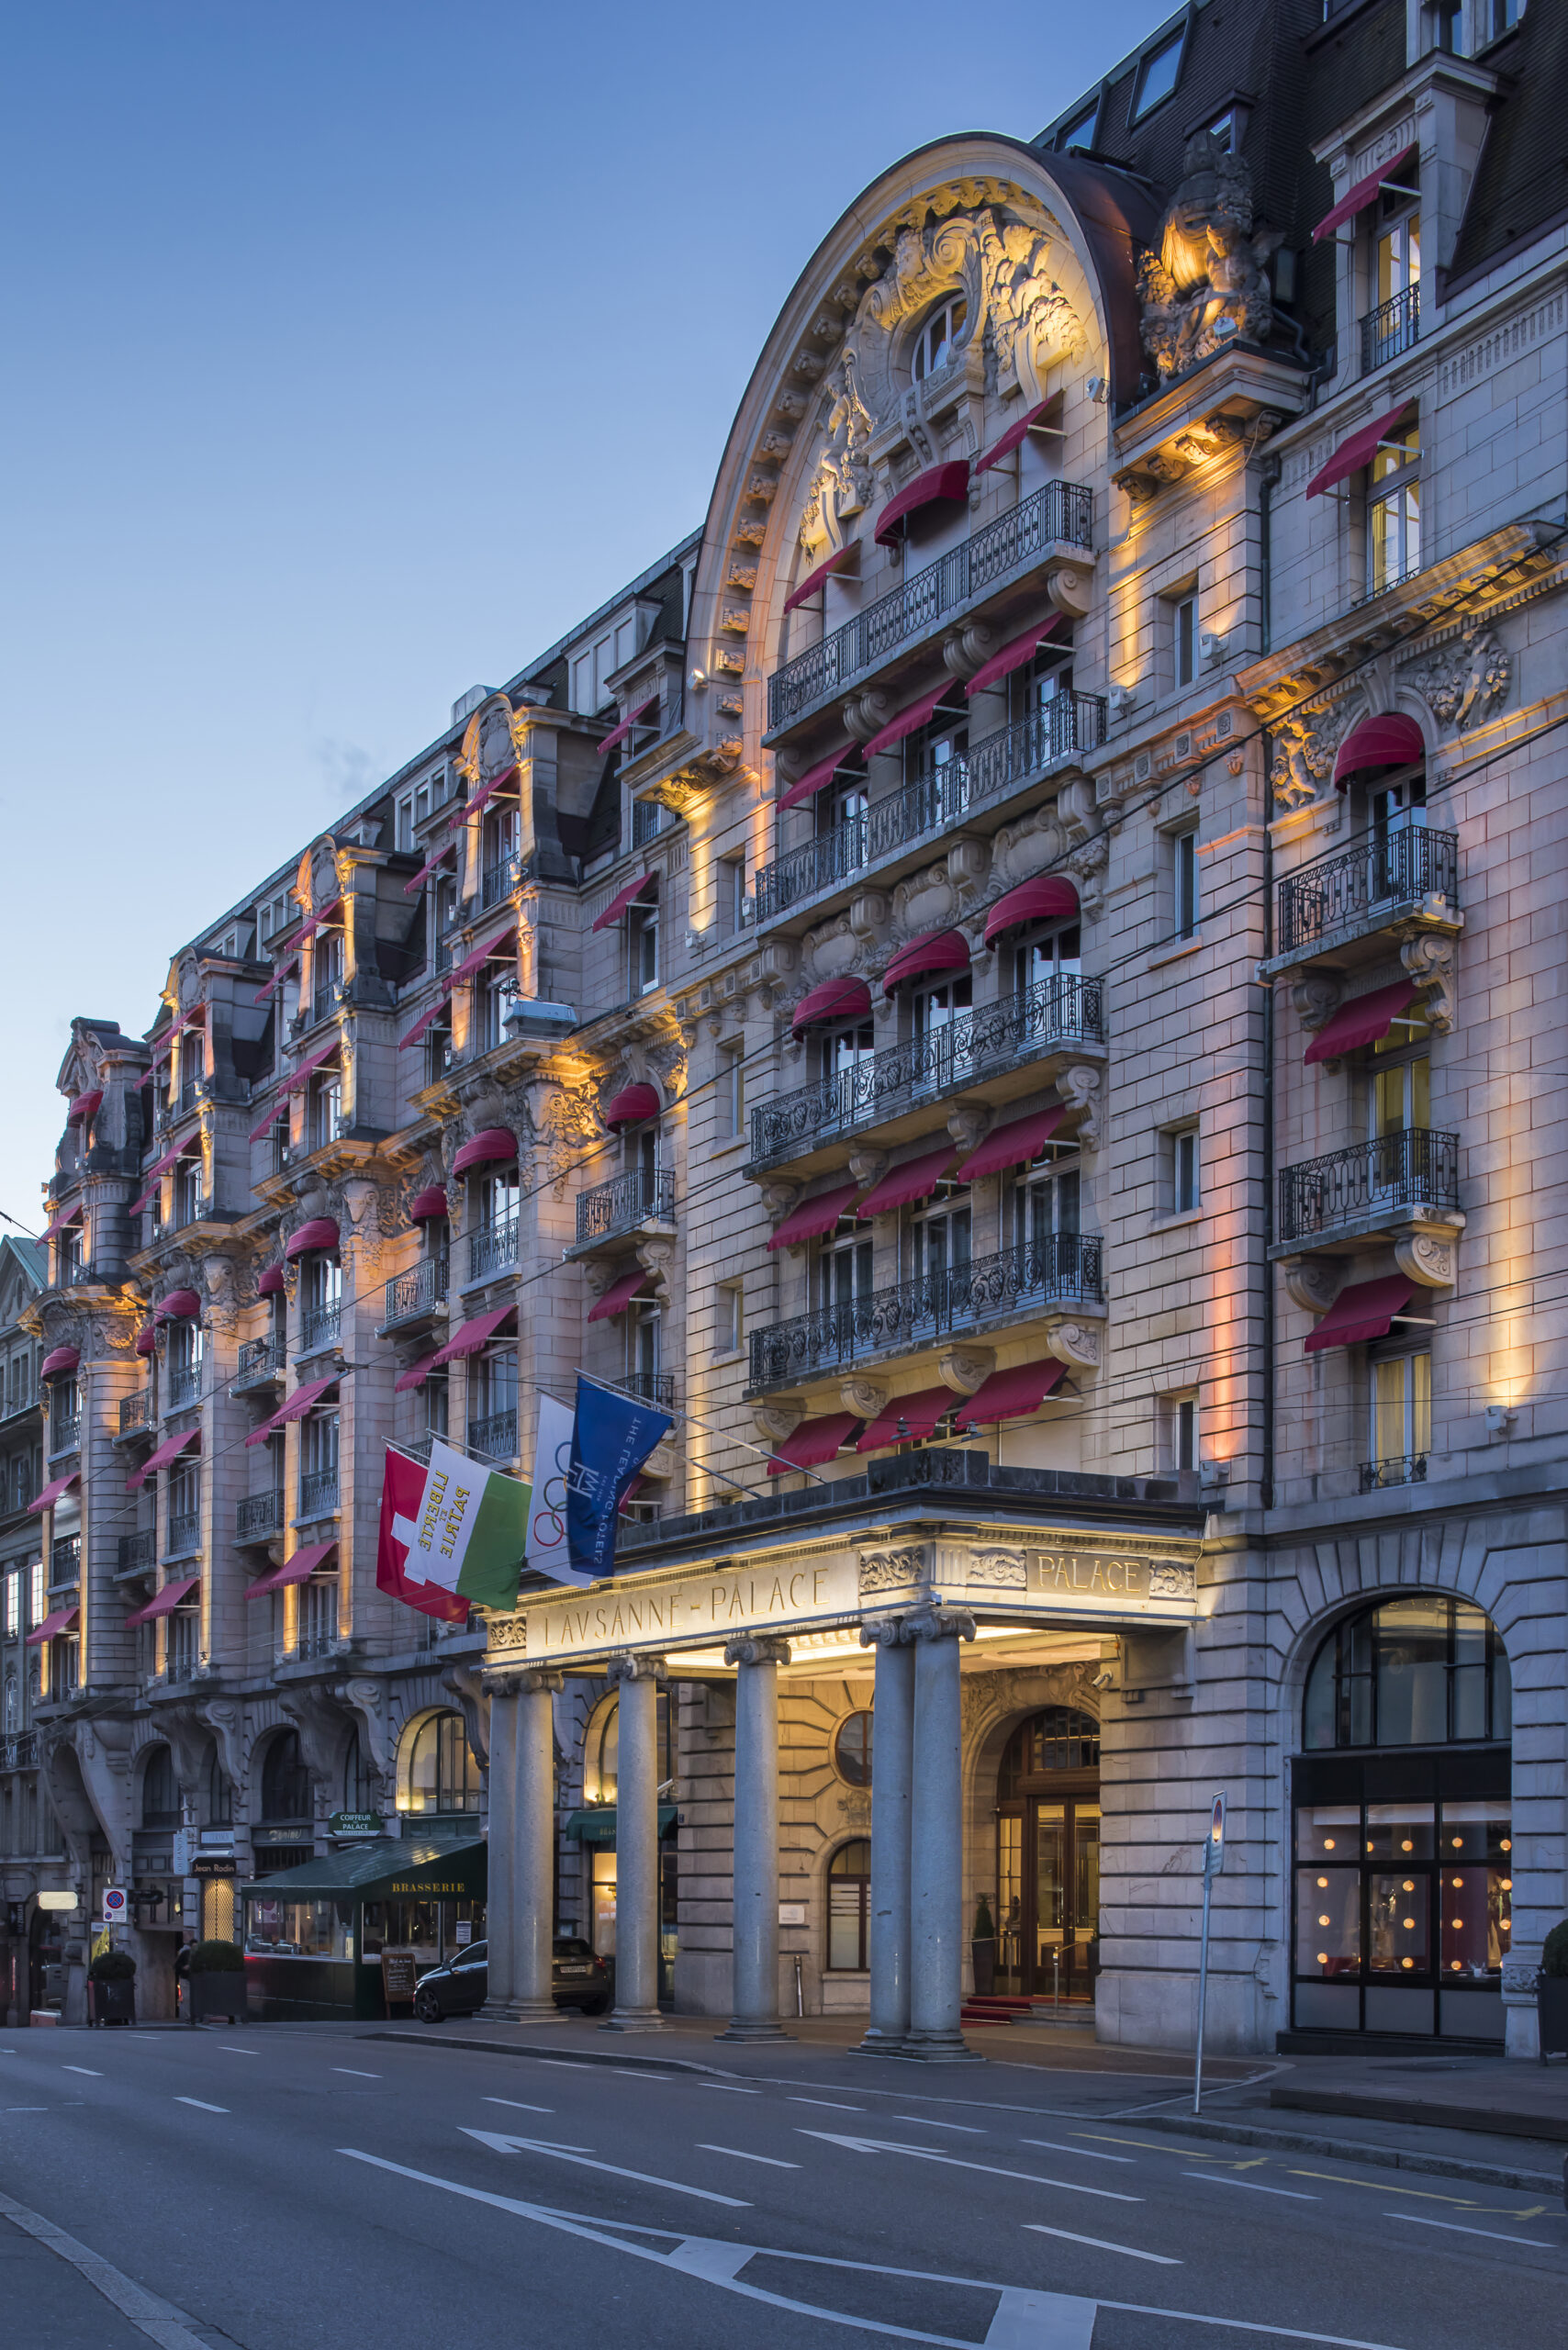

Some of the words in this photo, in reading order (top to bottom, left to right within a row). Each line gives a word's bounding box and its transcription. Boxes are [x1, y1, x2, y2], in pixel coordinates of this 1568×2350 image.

[1037, 1555, 1142, 1593] PALACE
[194, 1863, 211, 1873] Jean
[392, 1882, 465, 1893] BRASSERIE
